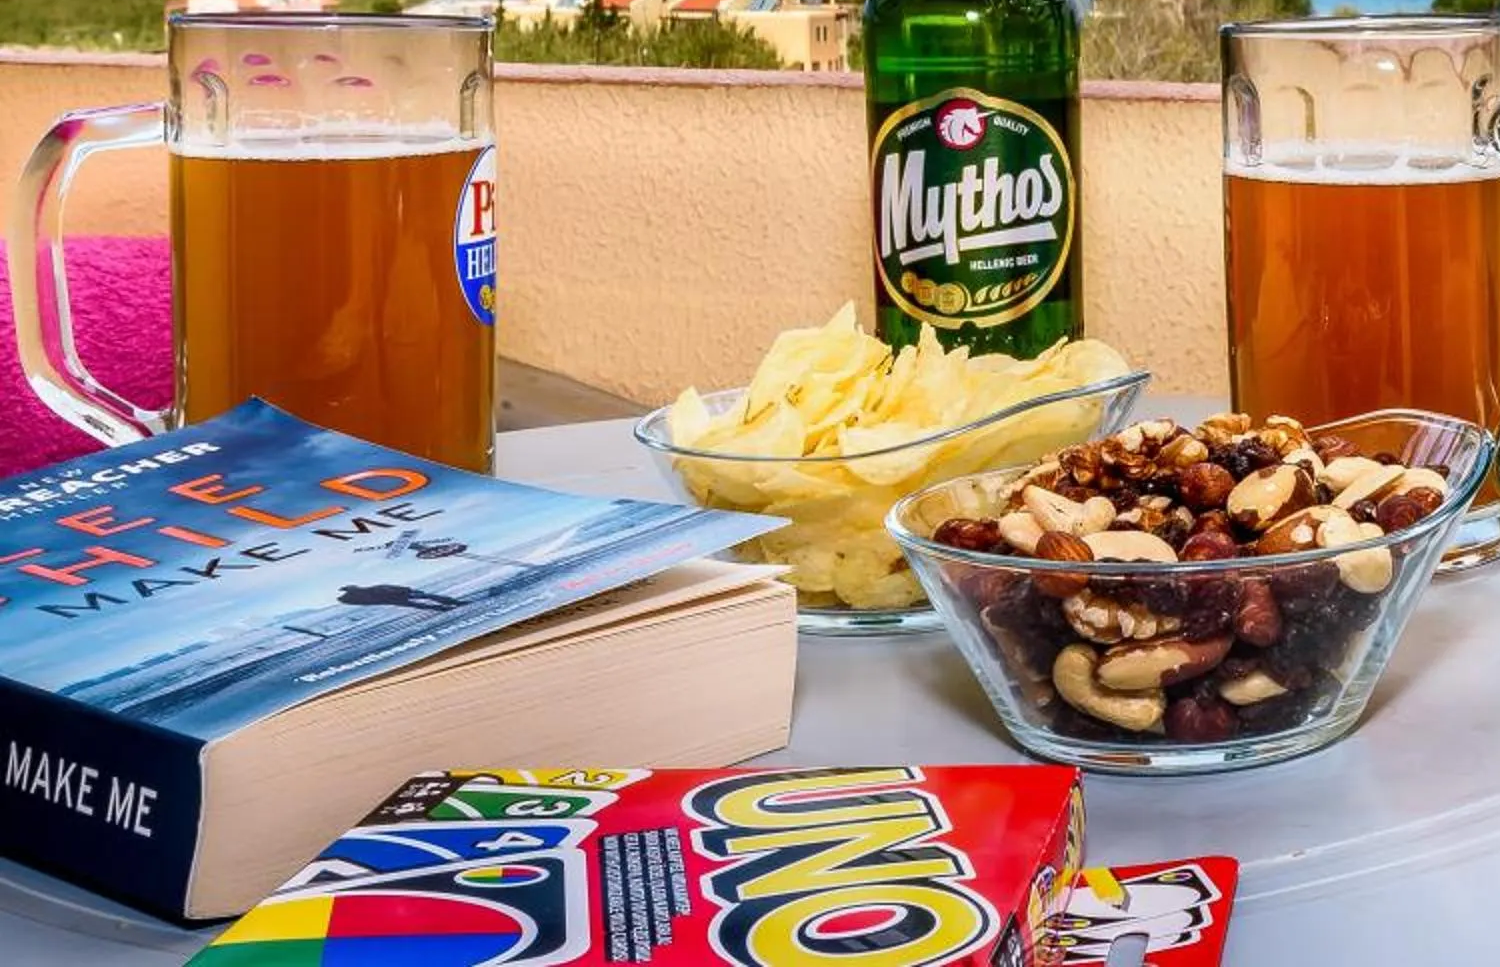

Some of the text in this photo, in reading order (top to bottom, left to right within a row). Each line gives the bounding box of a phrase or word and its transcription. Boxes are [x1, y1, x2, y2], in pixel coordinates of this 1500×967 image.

[993, 116, 1030, 136] QUALITY
[881, 150, 1063, 265] Mythos
[969, 253, 1039, 271] HELLENIC BEER
[0, 442, 221, 512] REACHER
[0, 481, 128, 521] HRILLER
[0, 468, 430, 609] HILD
[37, 541, 310, 619] MAKE
[312, 502, 445, 541] ME
[4, 741, 159, 838] MAKE ME
[550, 769, 613, 787] 2
[504, 797, 572, 818] 3
[475, 830, 547, 853] 4
[697, 767, 988, 967] UNO
